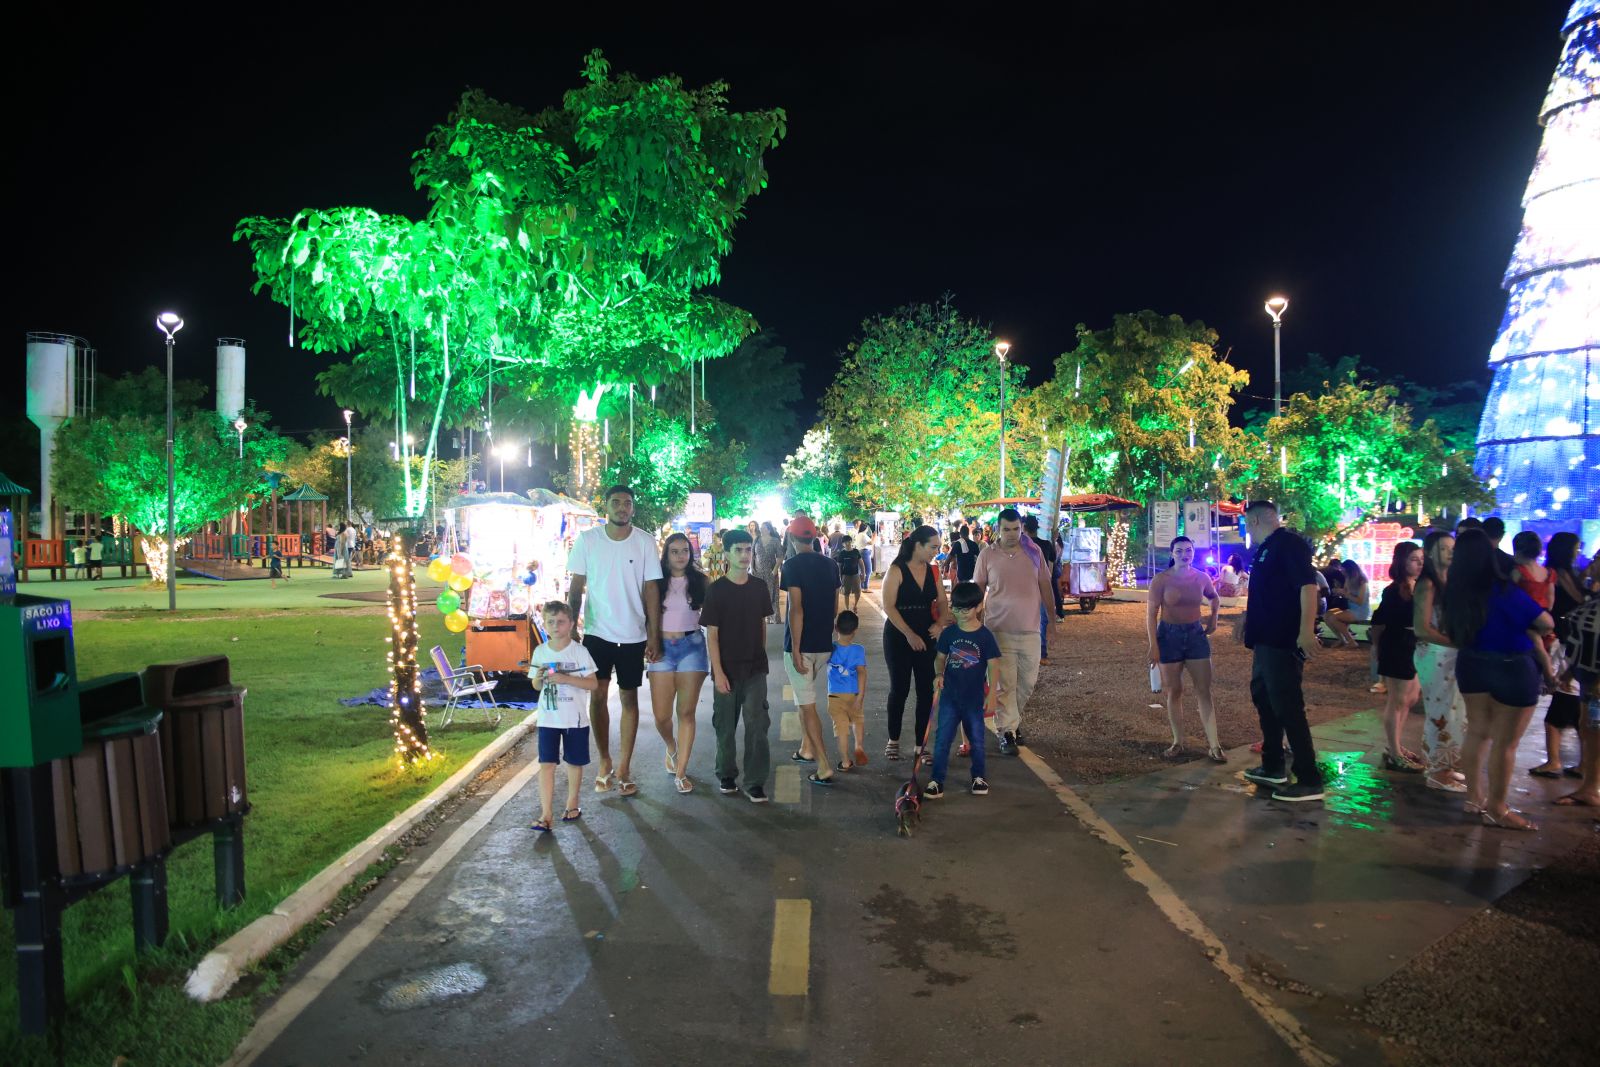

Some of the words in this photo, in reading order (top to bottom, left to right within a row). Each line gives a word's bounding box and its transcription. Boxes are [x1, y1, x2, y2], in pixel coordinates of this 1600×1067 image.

[25, 606, 53, 619] SACO
[55, 604, 69, 615] DE
[36, 618, 60, 630] LIXO
